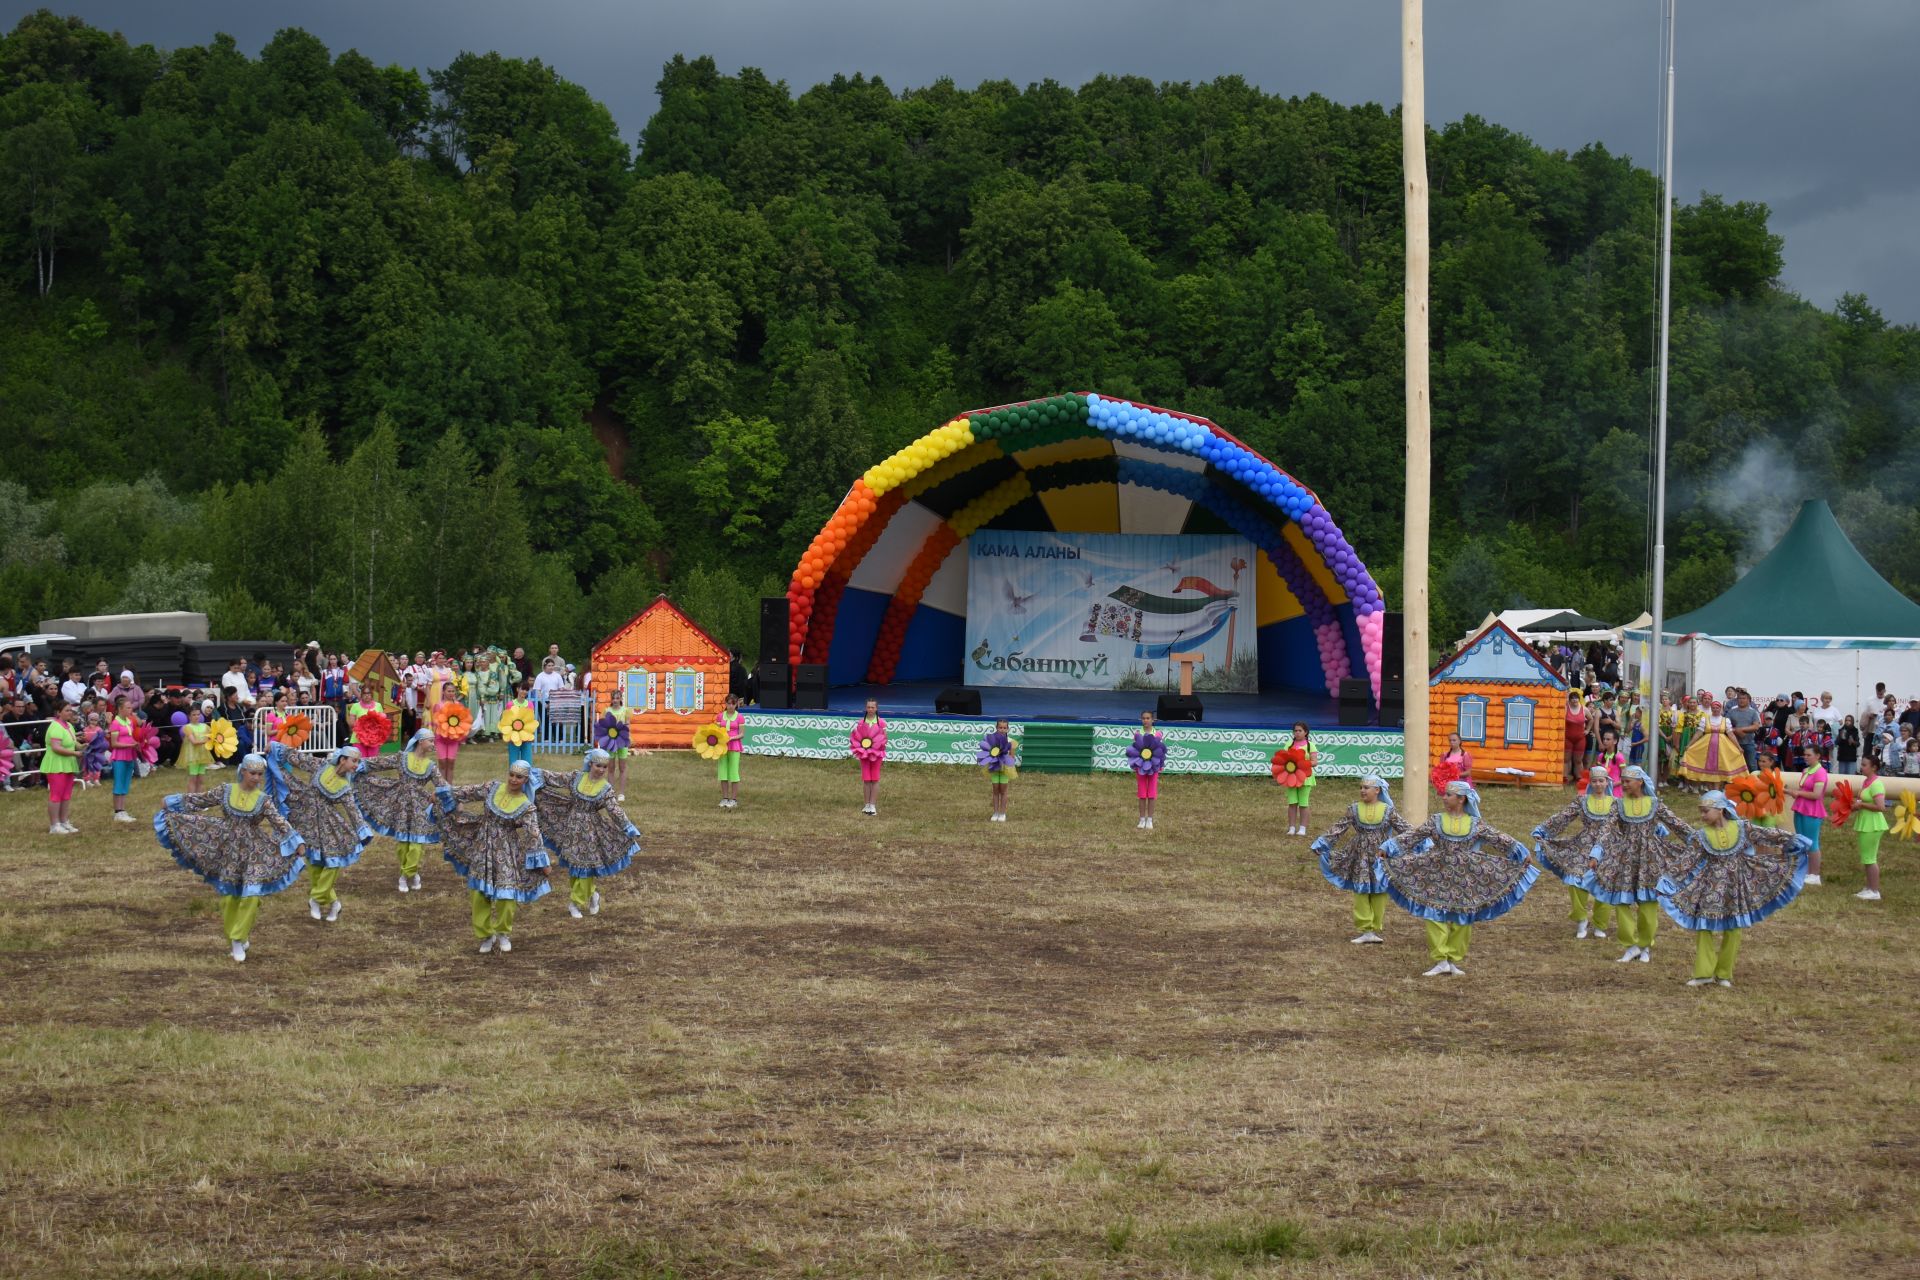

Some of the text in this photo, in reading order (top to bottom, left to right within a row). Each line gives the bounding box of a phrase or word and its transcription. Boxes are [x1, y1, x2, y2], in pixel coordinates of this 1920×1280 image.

[977, 544, 1081, 560] КАМА АЛАНЫ
[971, 645, 1110, 680] Сабантуй
